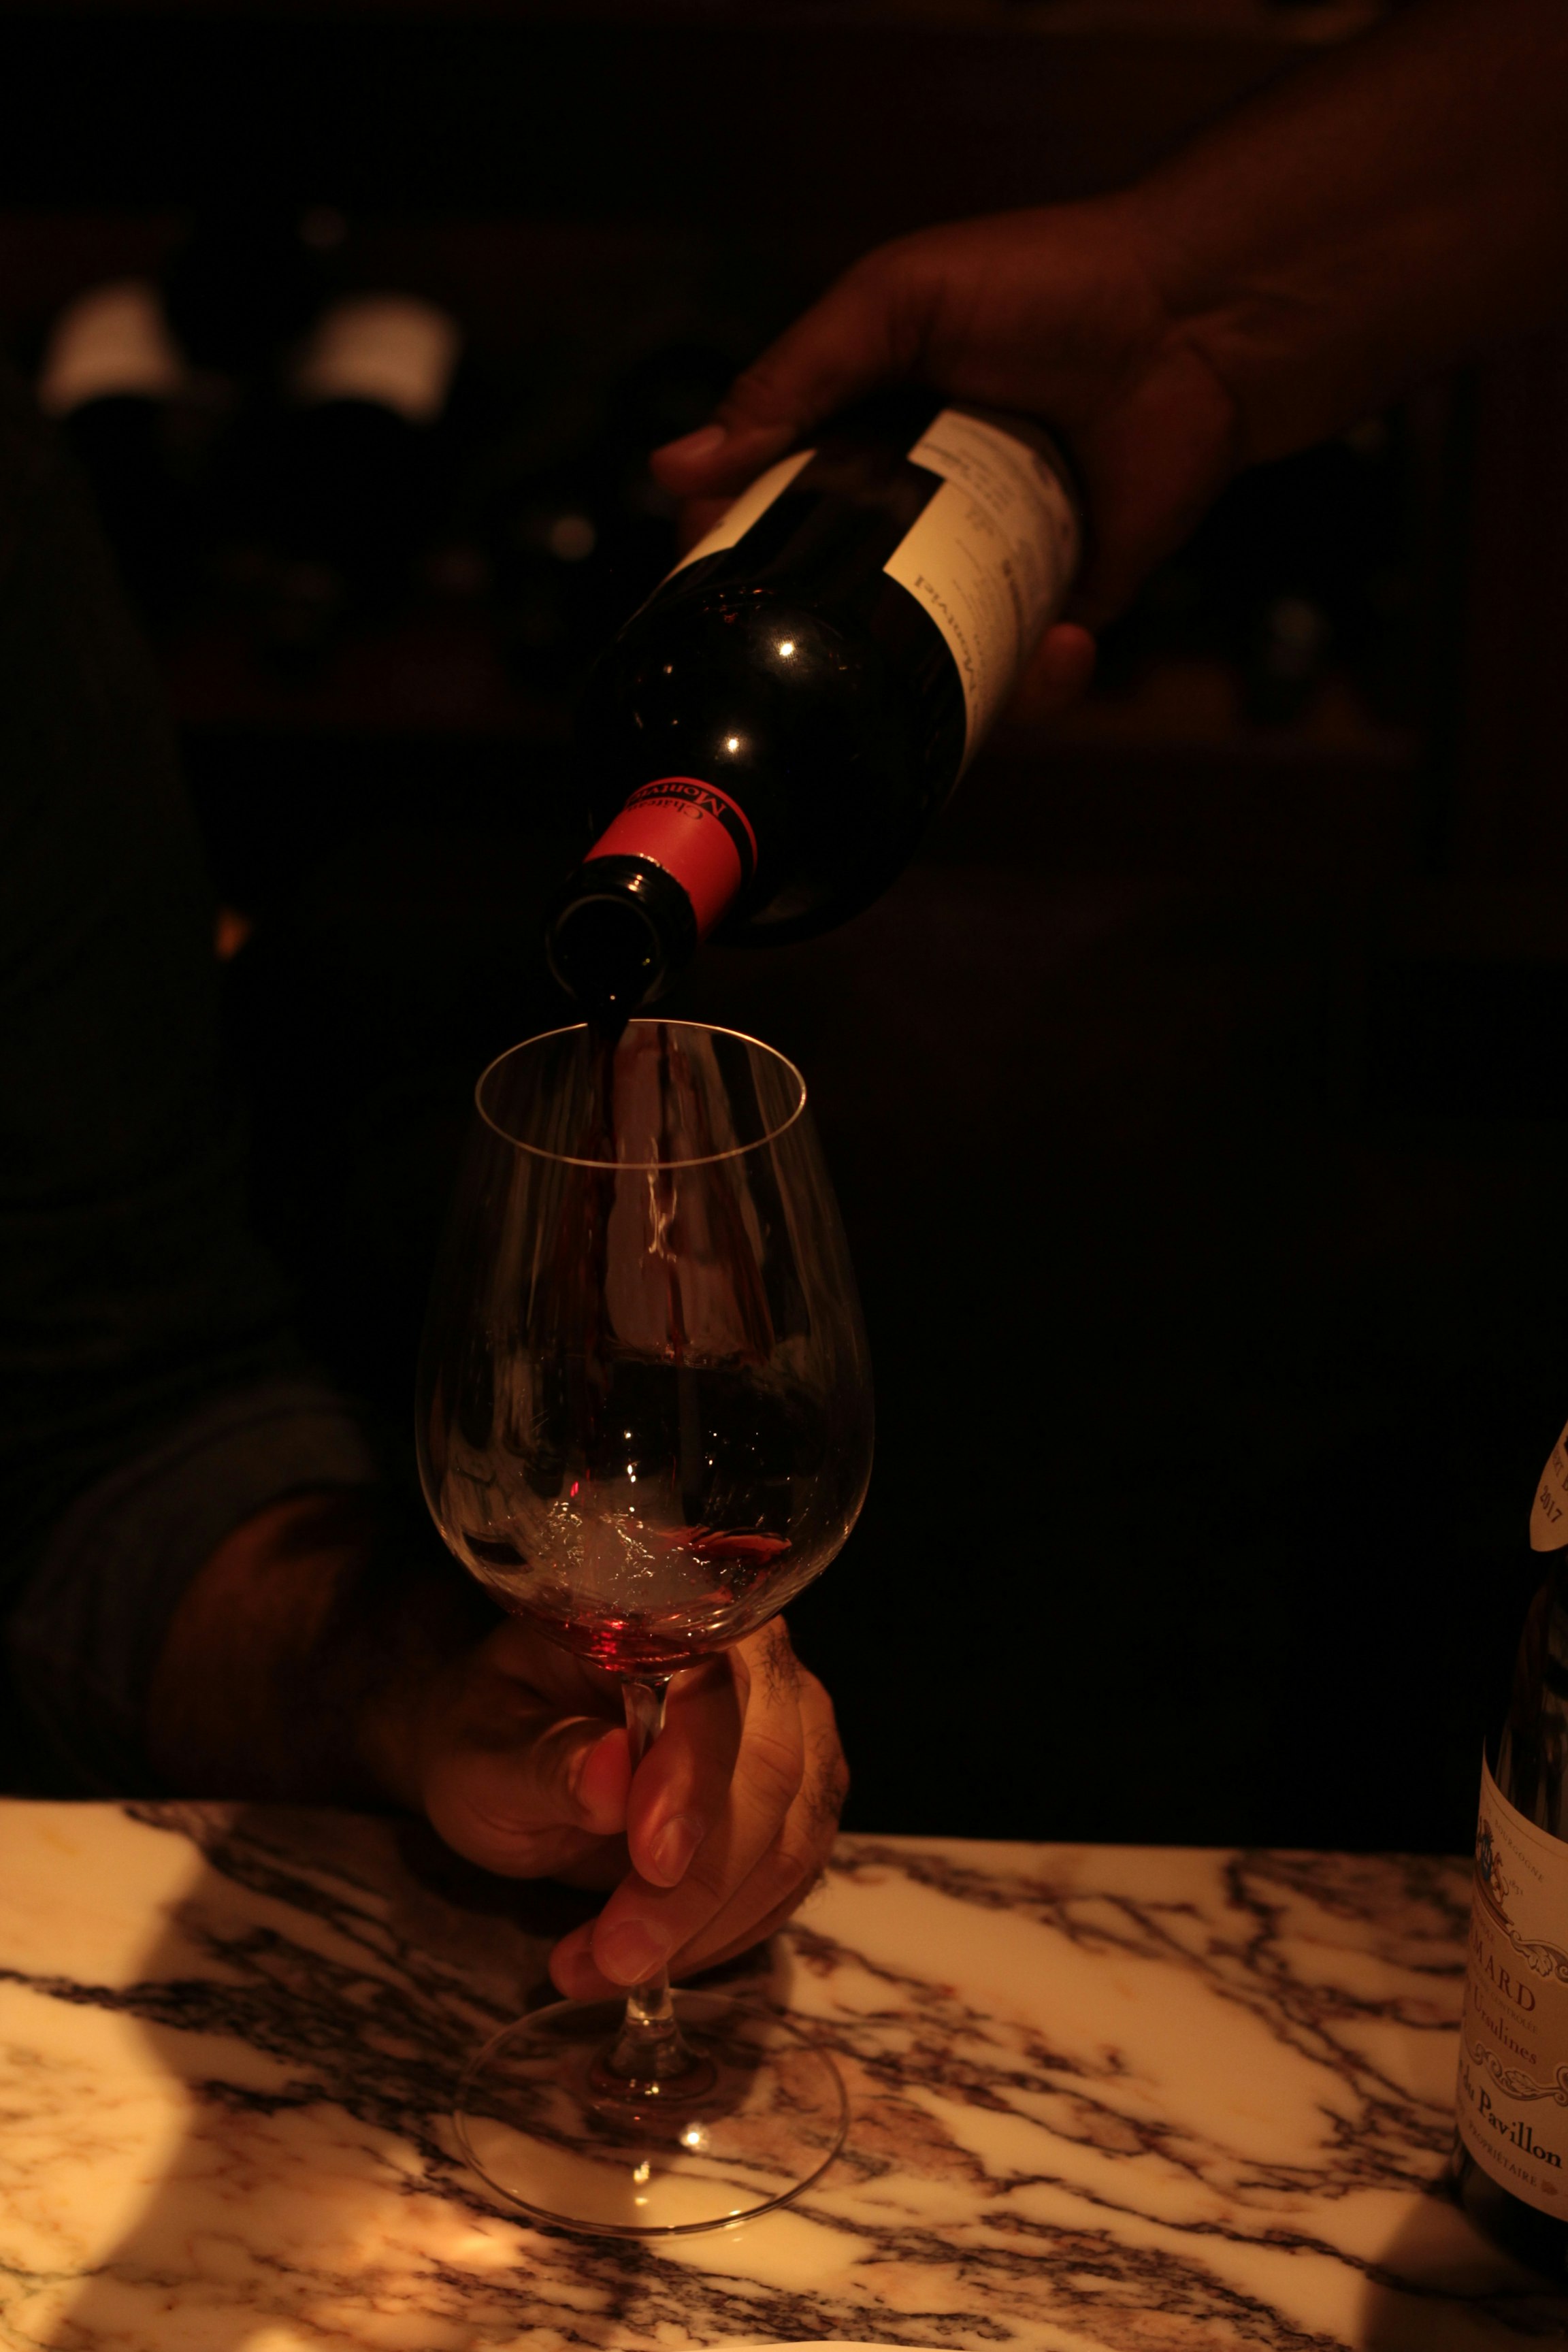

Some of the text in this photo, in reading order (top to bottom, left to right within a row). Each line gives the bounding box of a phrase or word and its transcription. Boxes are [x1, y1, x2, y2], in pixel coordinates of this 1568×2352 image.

[1539, 1485, 1563, 1523] 2017
[1494, 1819, 1545, 1883] BOURGOGNE
[1472, 1929, 1536, 2012] MARD
[1474, 1984, 1537, 2065] Ursulines
[1479, 2085, 1563, 2170] Pavillon
